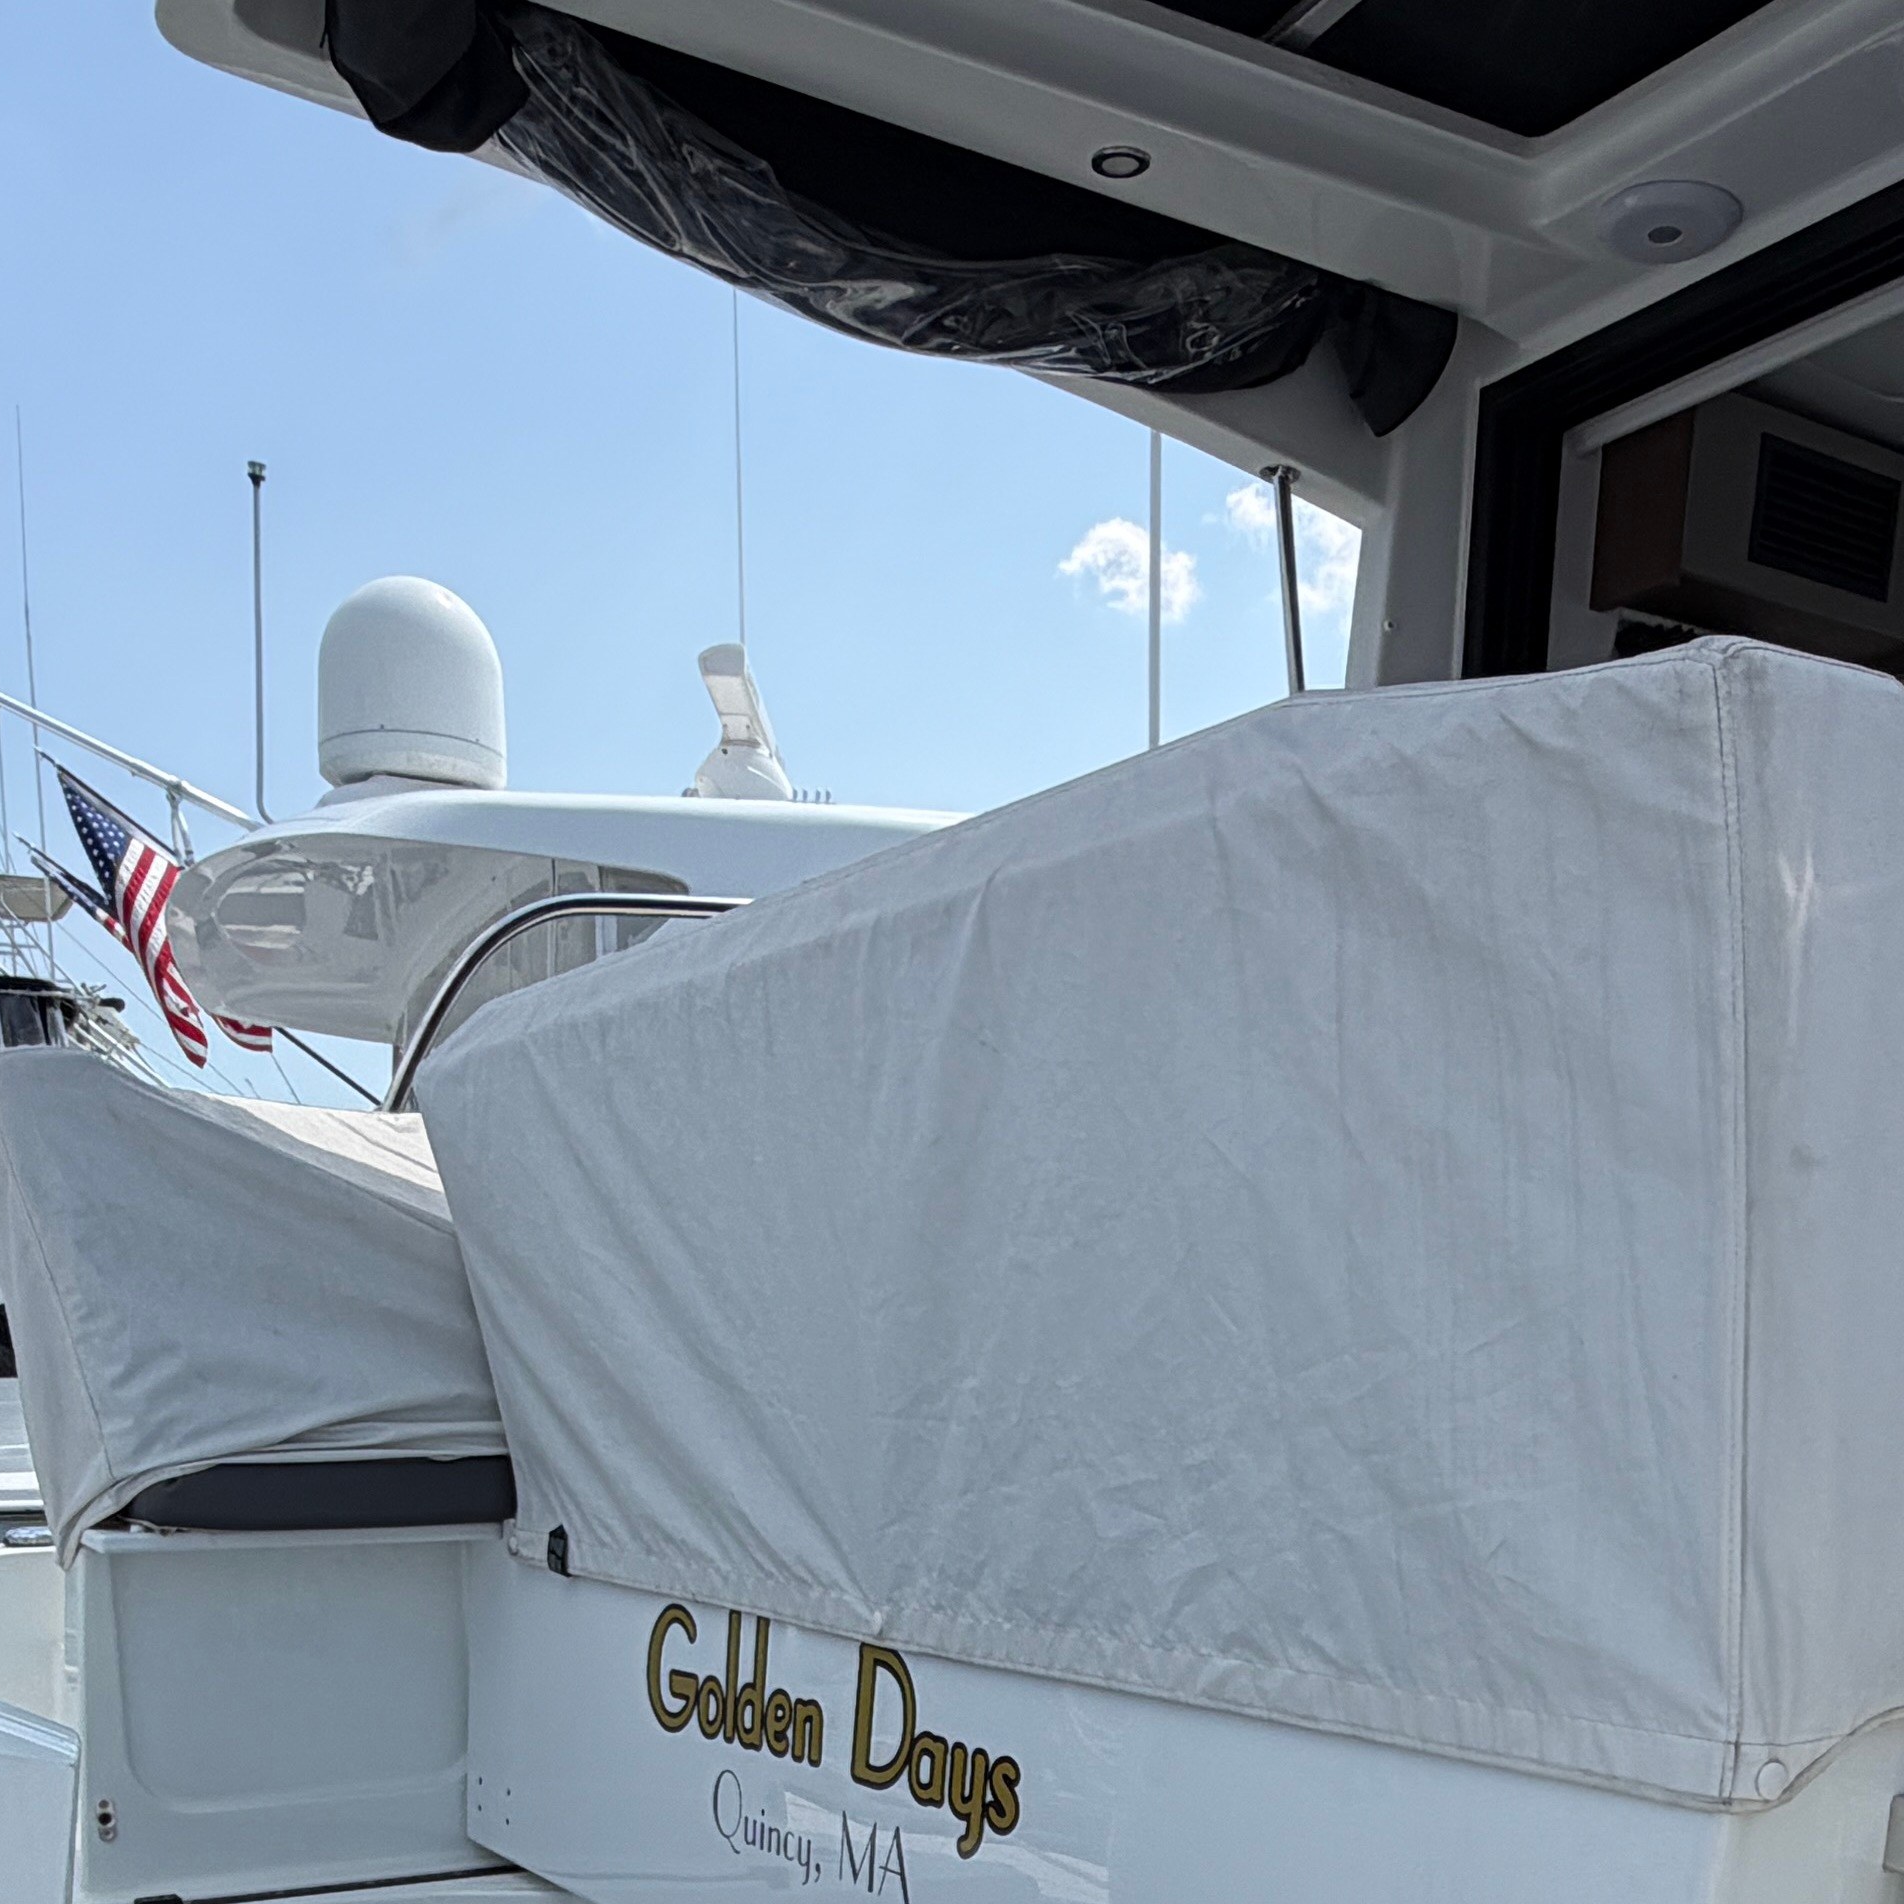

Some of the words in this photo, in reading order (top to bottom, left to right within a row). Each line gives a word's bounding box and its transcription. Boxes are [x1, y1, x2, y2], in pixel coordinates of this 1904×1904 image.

[647, 1603, 824, 1768] Golden
[851, 1642, 1021, 1859] Days
[713, 1769, 823, 1885] Quincy,
